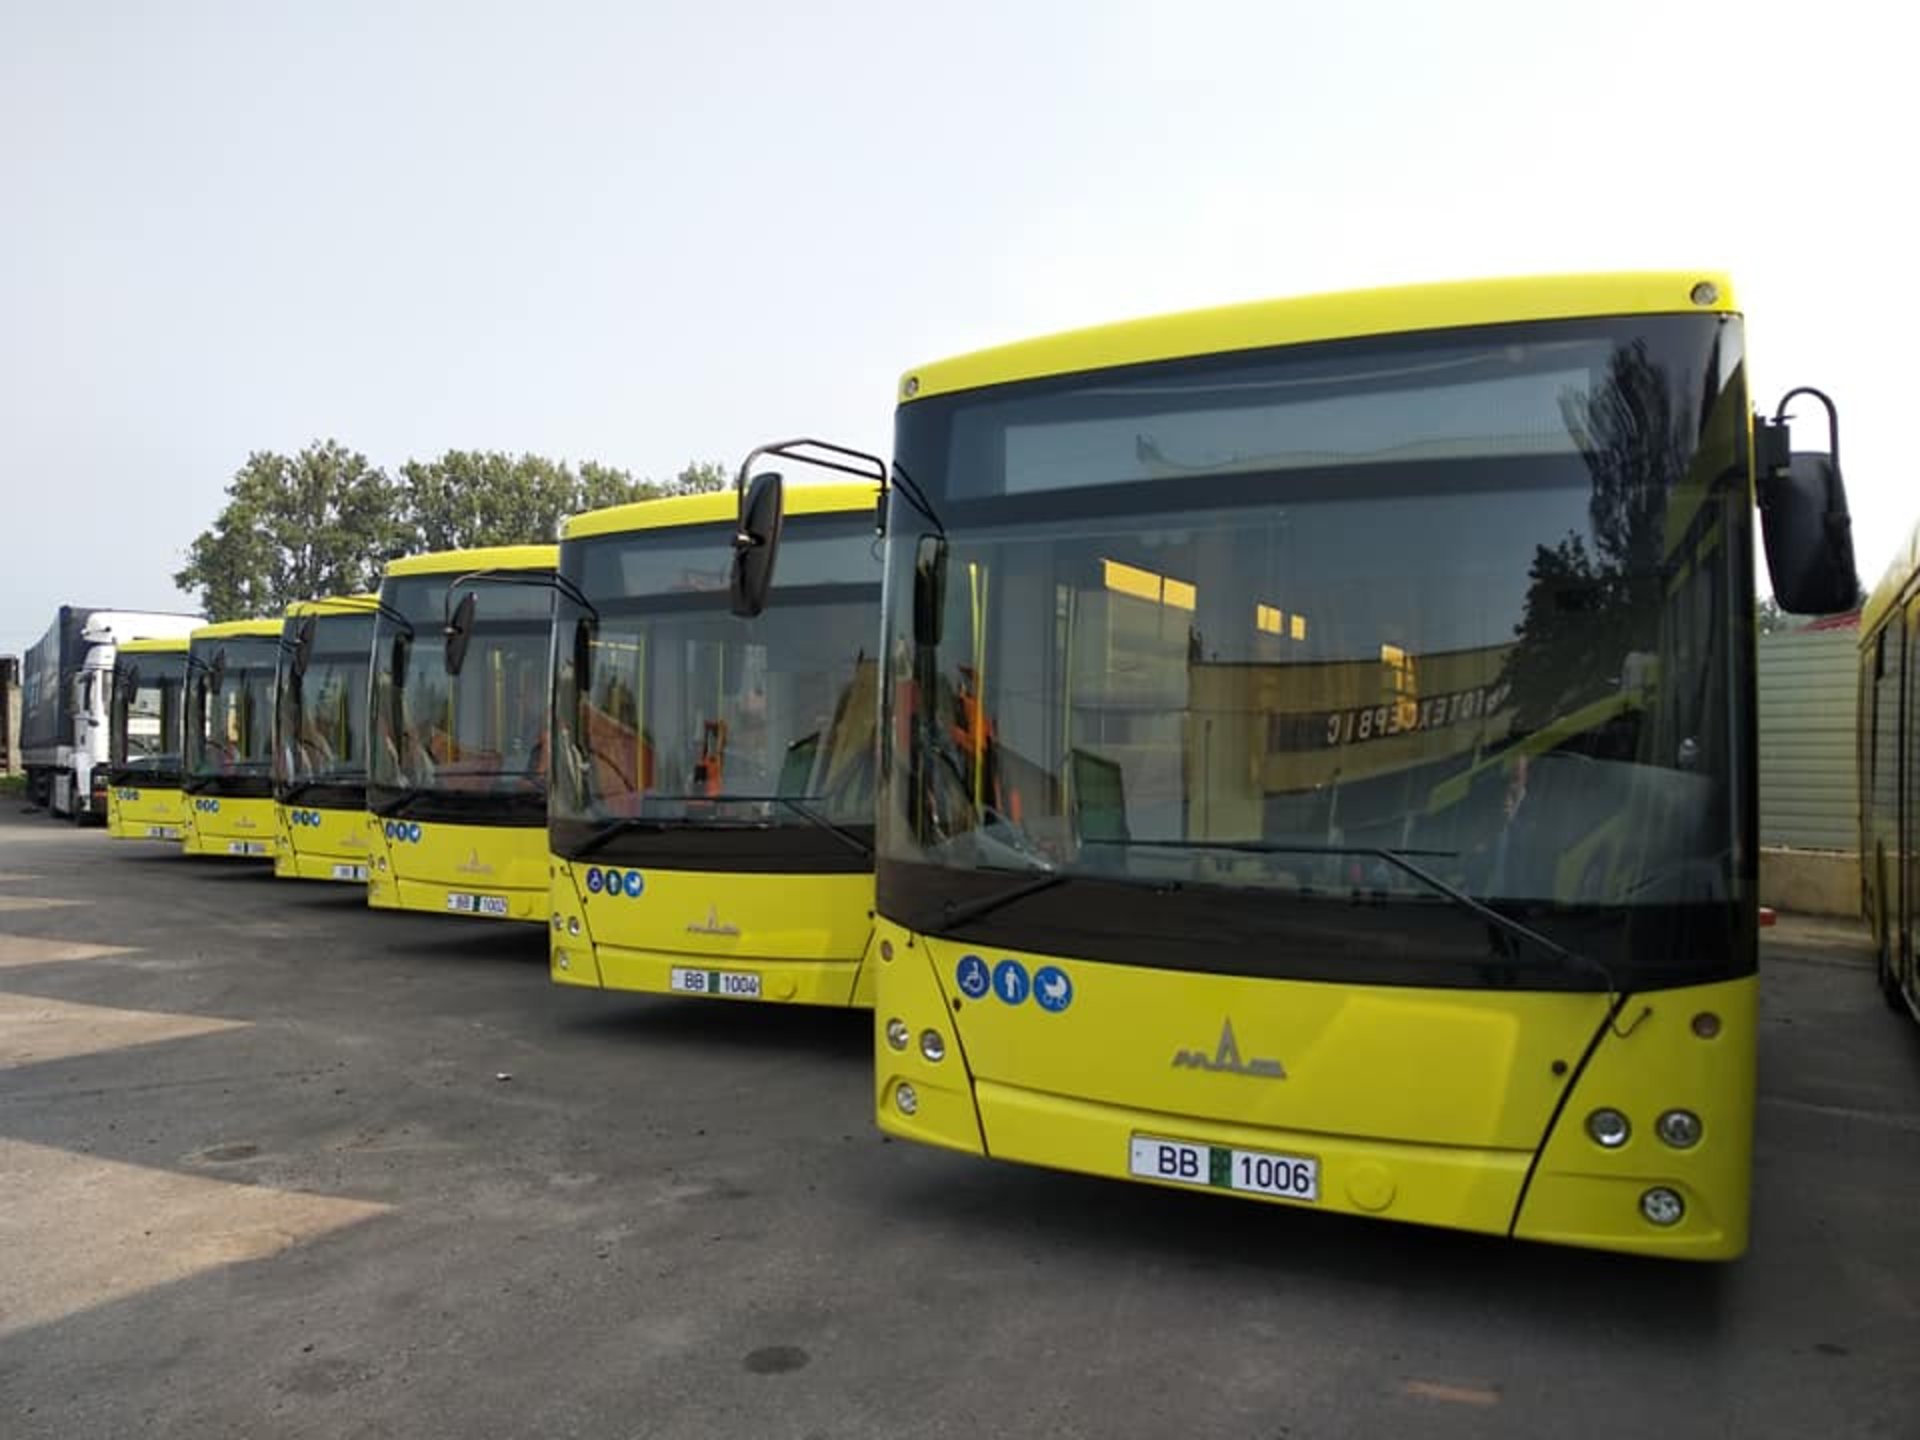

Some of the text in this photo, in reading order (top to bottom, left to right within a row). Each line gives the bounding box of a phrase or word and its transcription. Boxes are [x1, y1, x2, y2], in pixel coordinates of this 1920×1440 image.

[684, 971, 705, 990] BB
[1158, 1145, 1310, 1193] BB 1006
